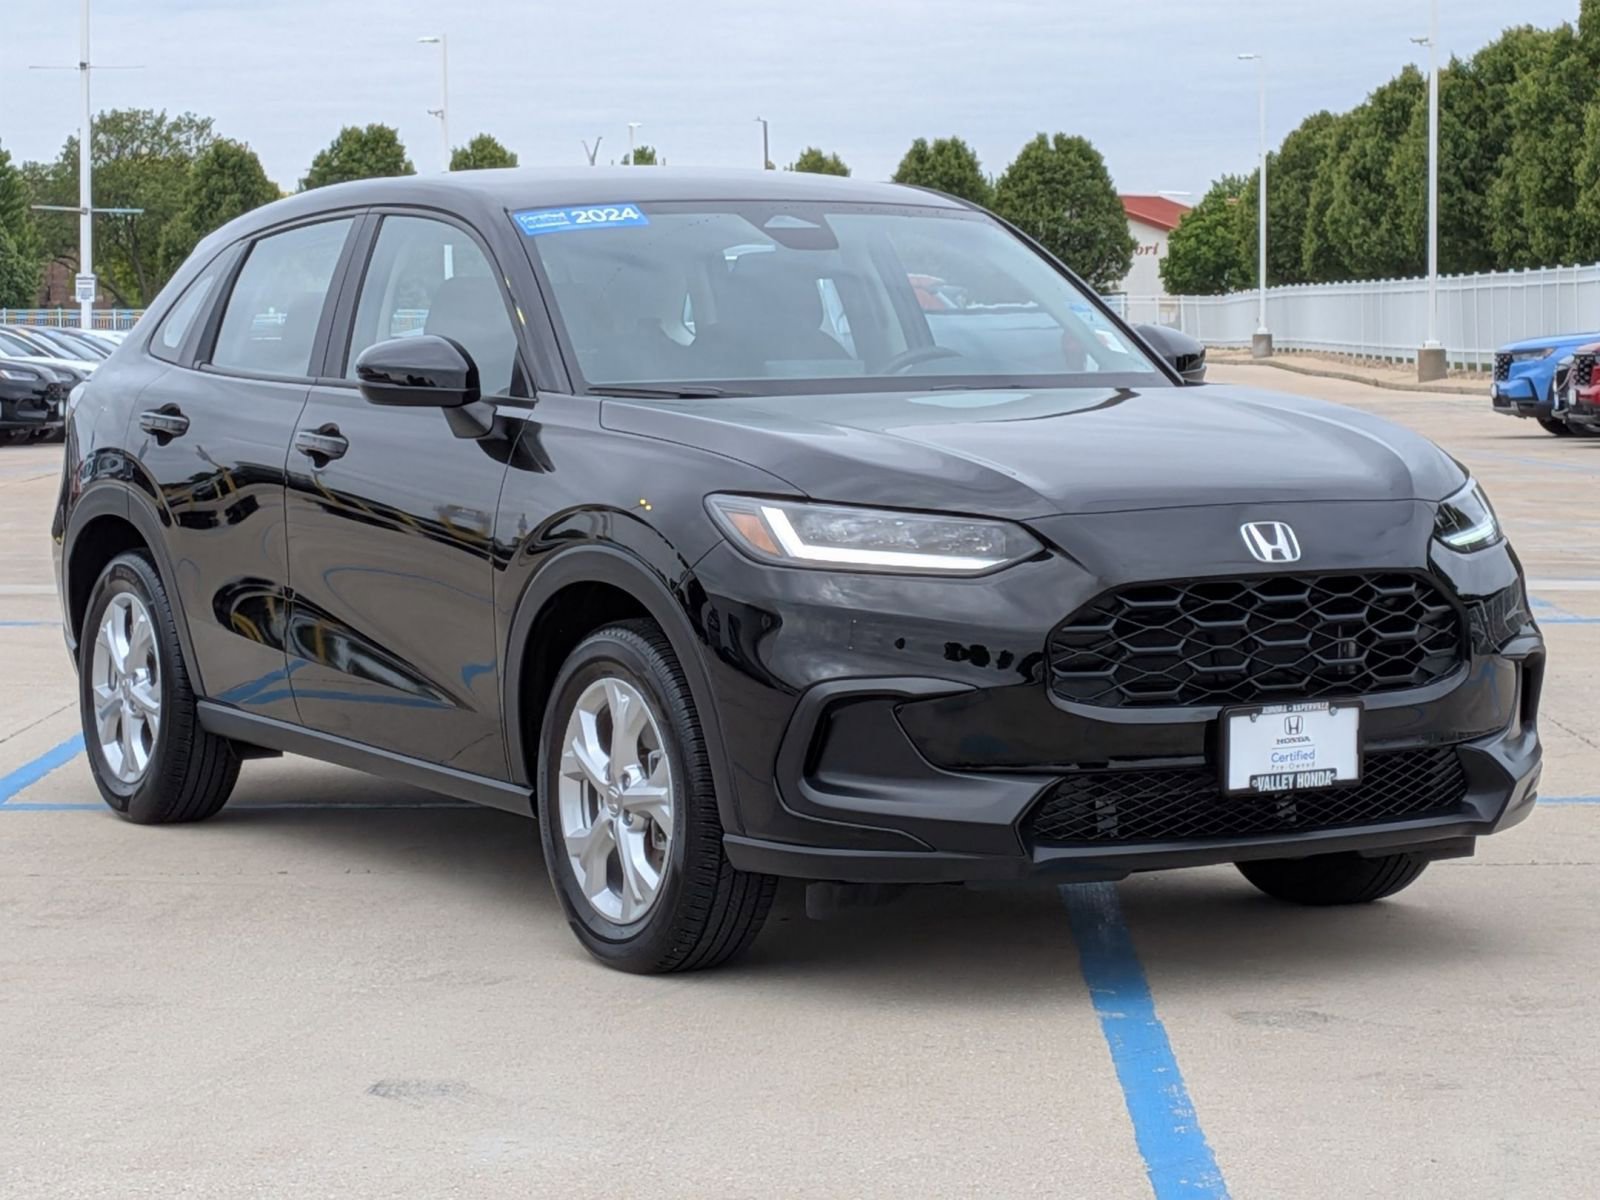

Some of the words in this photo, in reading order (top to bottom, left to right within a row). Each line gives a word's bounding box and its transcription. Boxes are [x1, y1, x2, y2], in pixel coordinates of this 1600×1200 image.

[571, 208, 639, 224] 2024
[1276, 736, 1311, 745] HONDA
[1271, 749, 1315, 763] Certified
[1257, 774, 1295, 792] VALLEY
[1296, 770, 1333, 789] HONDA
